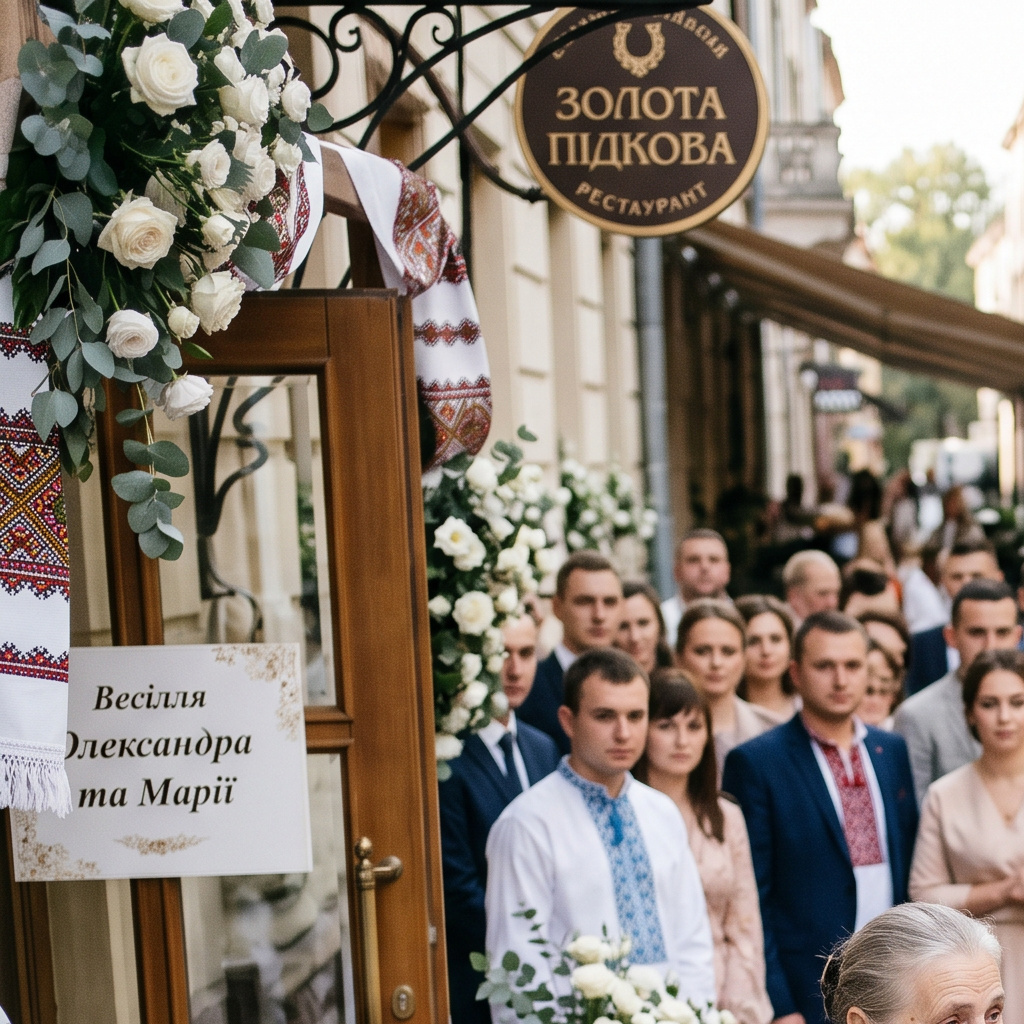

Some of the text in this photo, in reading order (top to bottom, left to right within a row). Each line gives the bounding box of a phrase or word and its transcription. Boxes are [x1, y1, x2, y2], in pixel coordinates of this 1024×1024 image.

[555, 86, 727, 121] ЗОЛОТА
[547, 131, 737, 171] ПІДКОВА
[575, 180, 707, 216] РЕСТАУРАНТ
[92, 683, 207, 711] Весілля
[78, 775, 238, 813] та Марії
